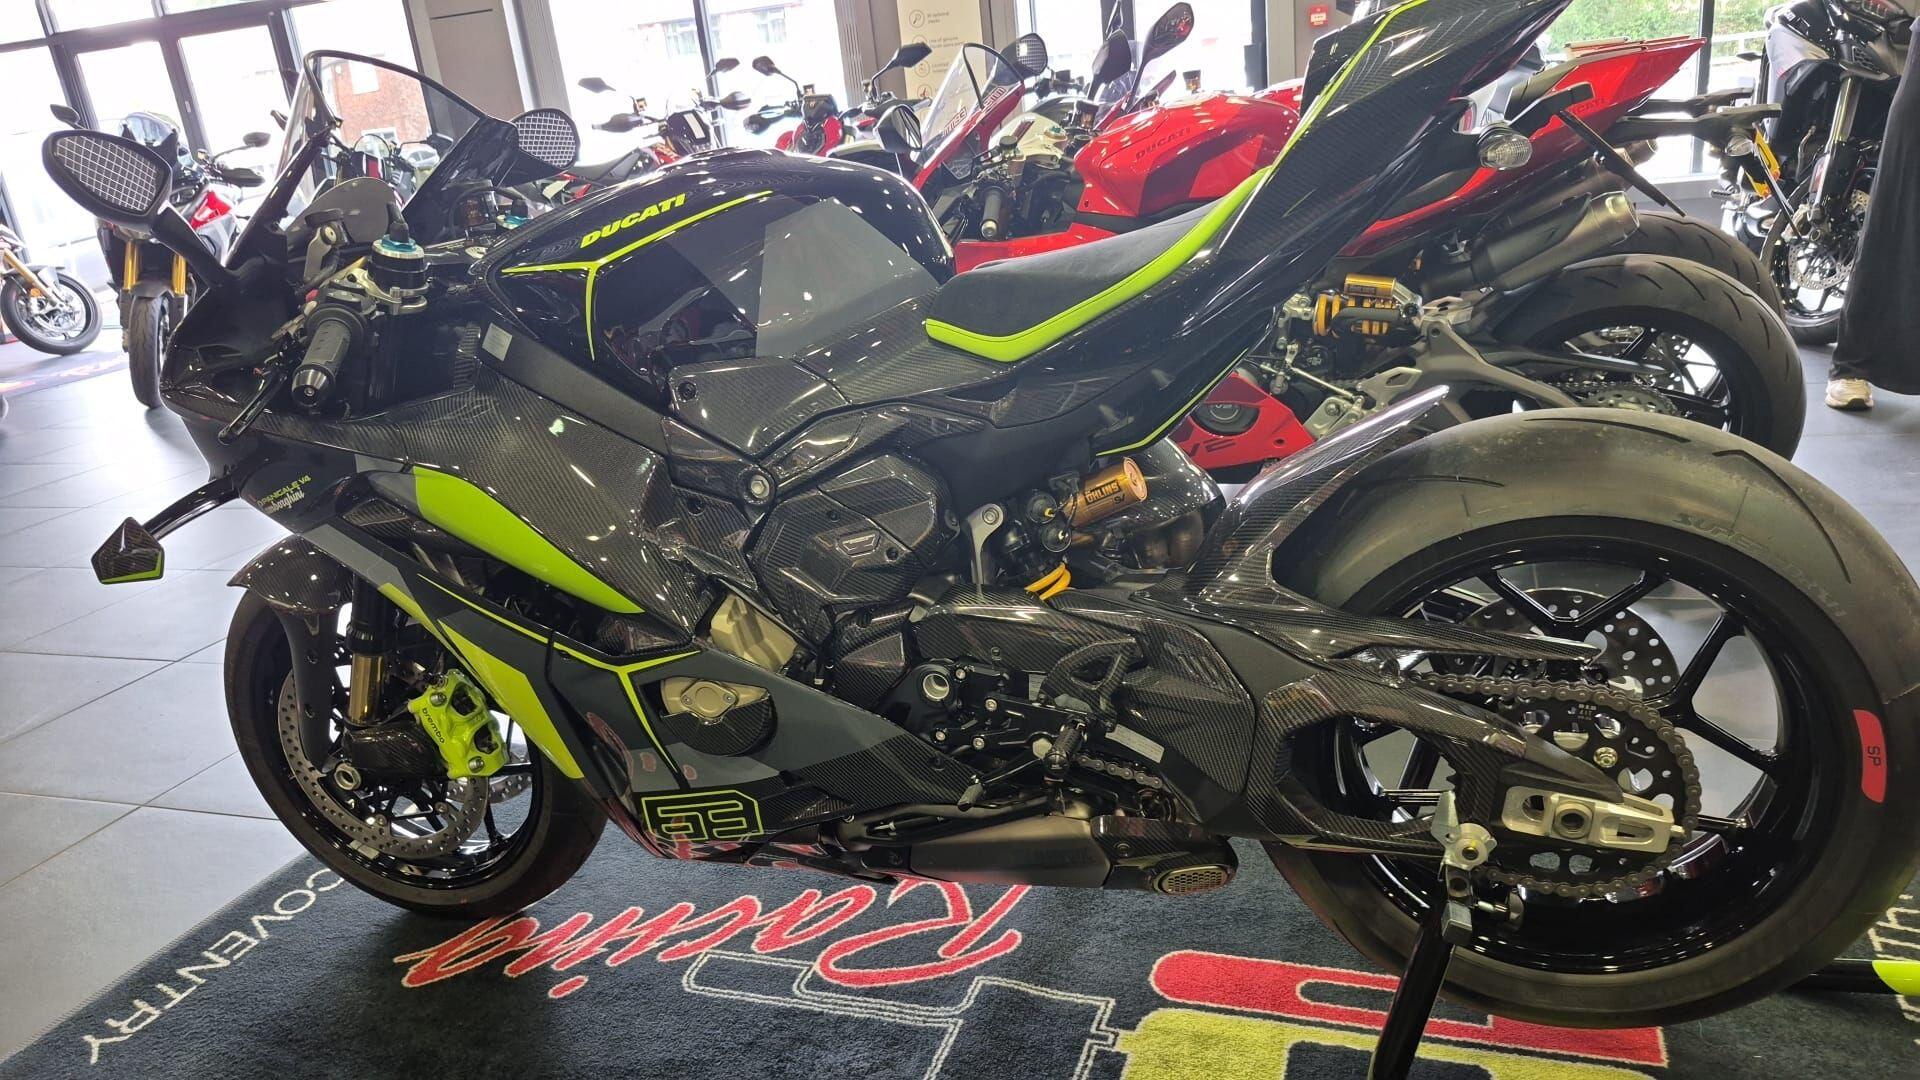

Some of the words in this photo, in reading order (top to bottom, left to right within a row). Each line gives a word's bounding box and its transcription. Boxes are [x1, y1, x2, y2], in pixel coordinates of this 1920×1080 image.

[1136, 127, 1191, 158] DUCATI
[580, 193, 685, 248] DUCATI
[264, 486, 305, 515] borghini
[422, 707, 445, 744] brembo
[1867, 745, 1882, 767] SP
[641, 790, 764, 842] 63
[394, 883, 1030, 999] Racing
[82, 868, 347, 1066] COVENTRY
